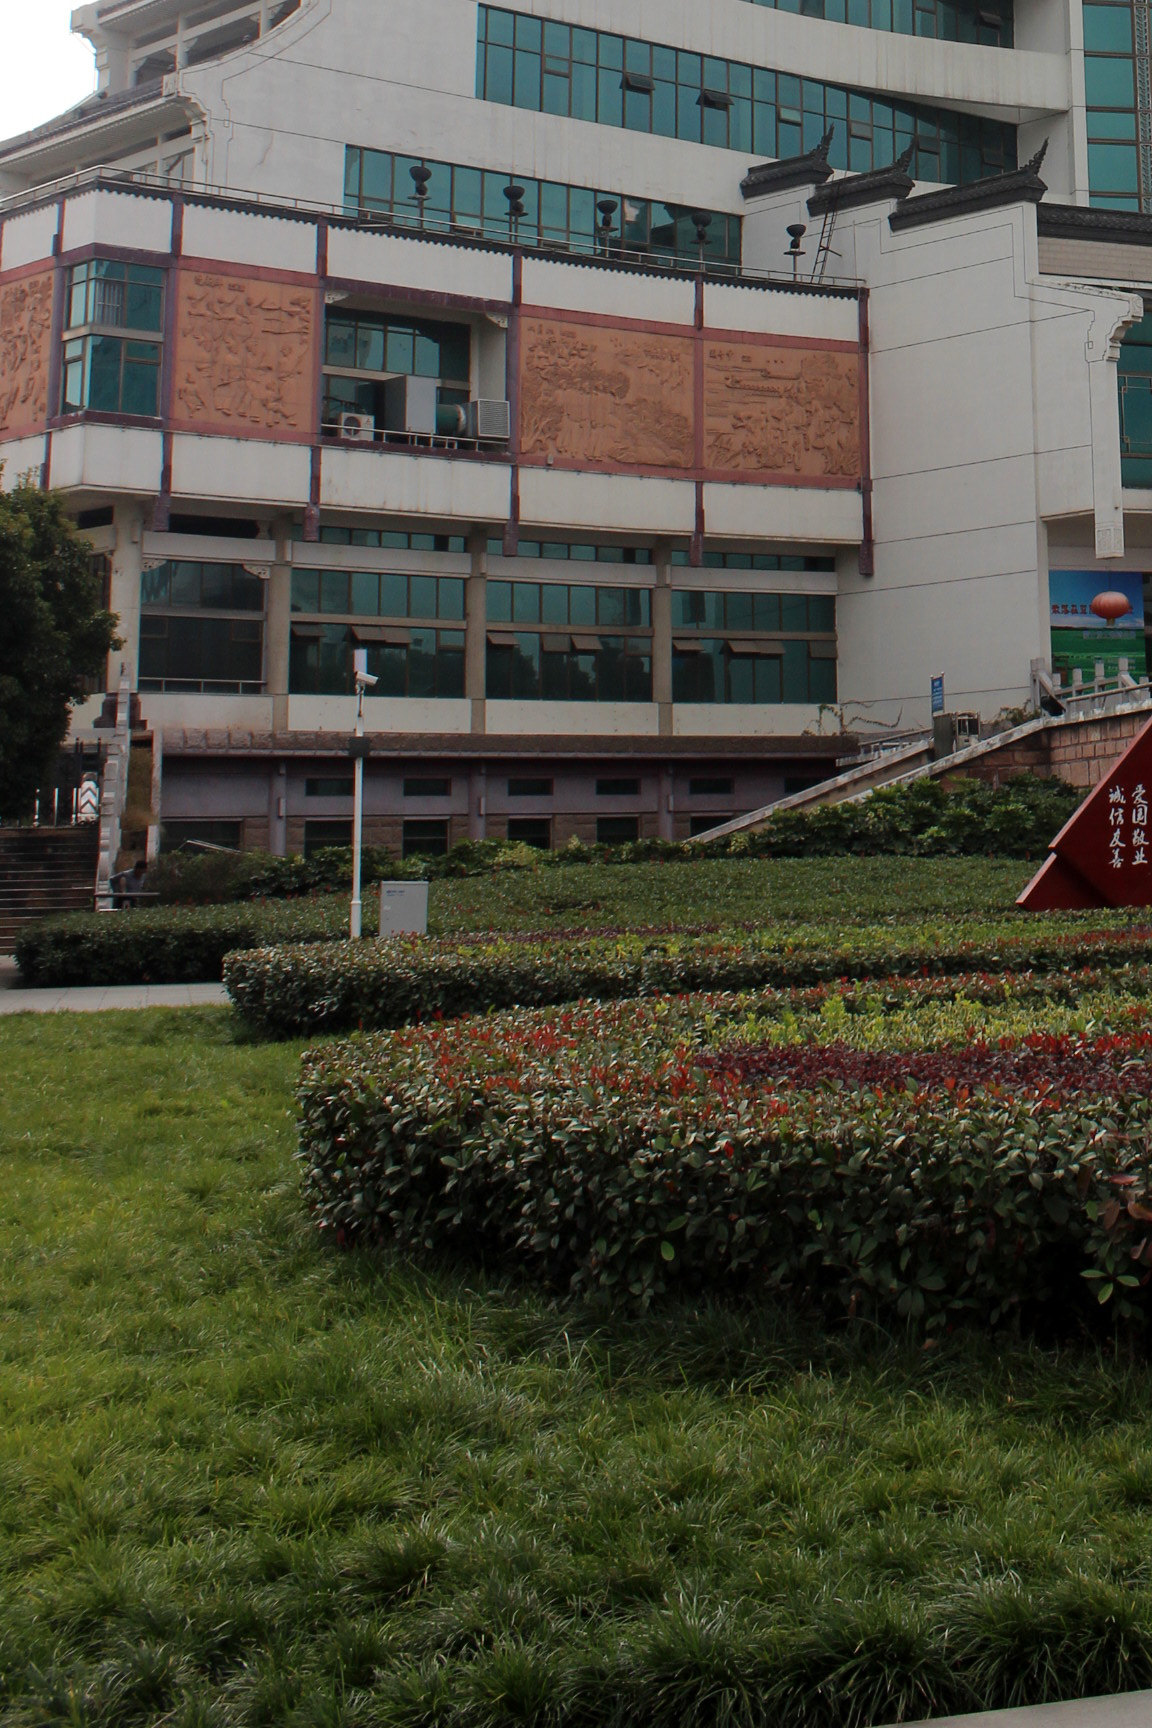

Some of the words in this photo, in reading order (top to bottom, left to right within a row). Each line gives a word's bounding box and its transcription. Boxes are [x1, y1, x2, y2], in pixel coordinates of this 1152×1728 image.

[1108, 785, 1126, 868] 诚信友善
[1131, 783, 1149, 865] 爱国敬业
